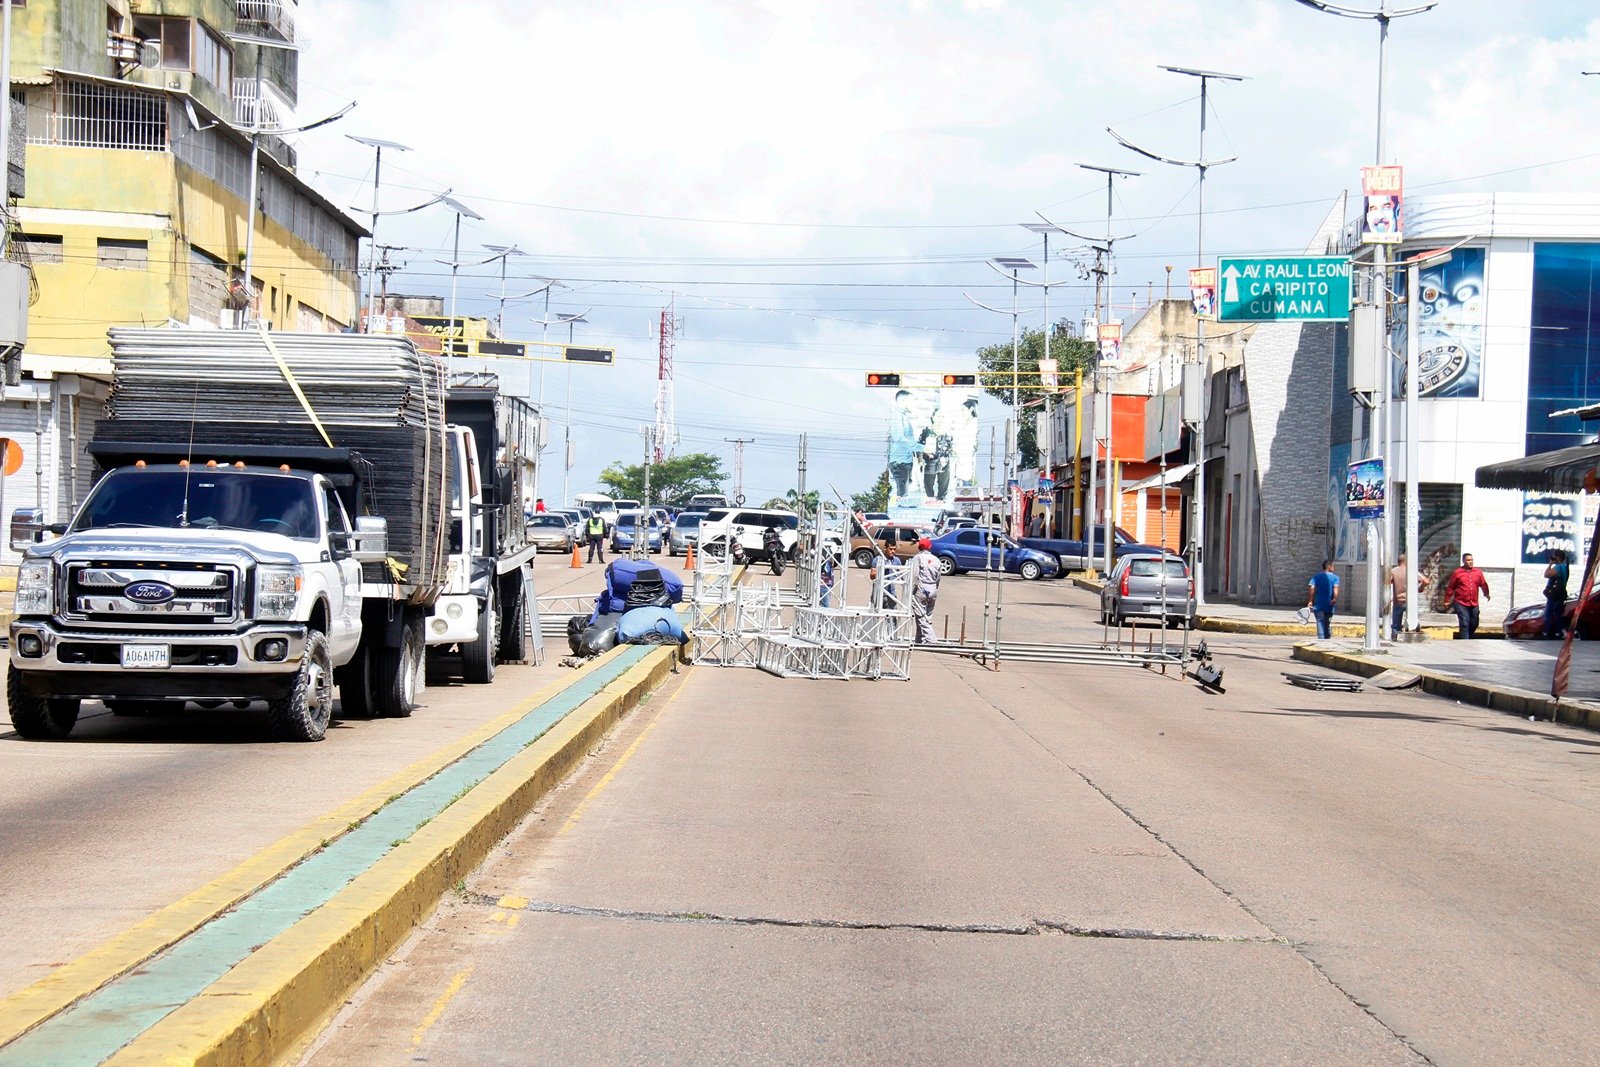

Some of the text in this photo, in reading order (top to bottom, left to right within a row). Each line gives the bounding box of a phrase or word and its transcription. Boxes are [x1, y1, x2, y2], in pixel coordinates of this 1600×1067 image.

[1243, 263, 1349, 278] AV. RAUL LEONI
[1250, 282, 1328, 296] CARIPITO
[1250, 300, 1325, 314] CUMANA
[135, 586, 163, 598] Ford
[126, 650, 166, 661] A06AH7H
